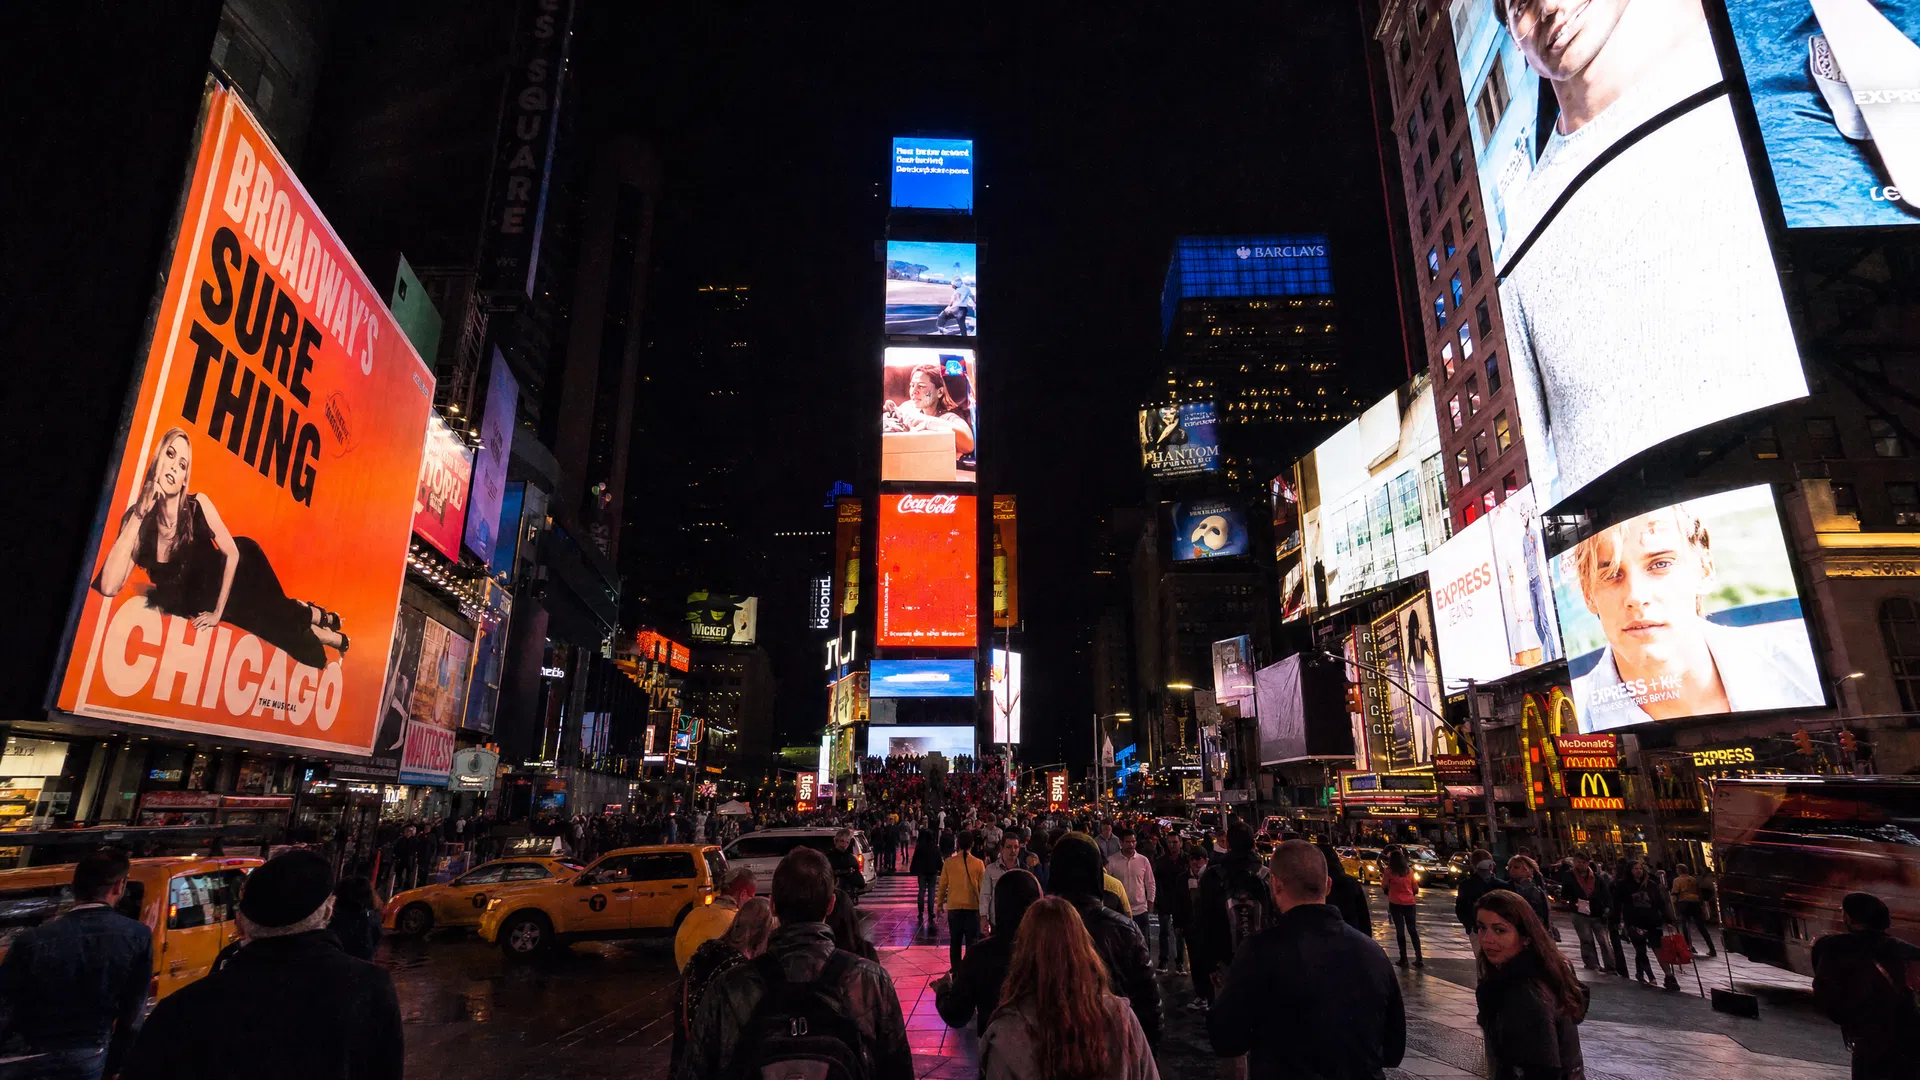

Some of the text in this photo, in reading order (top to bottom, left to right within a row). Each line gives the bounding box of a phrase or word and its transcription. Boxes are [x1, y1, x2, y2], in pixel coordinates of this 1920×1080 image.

[501, 58, 548, 234] SQUARE
[222, 134, 379, 376] BROADWAY'S
[1255, 245, 1325, 258] BARCLAYS
[200, 226, 322, 408] SURE
[181, 319, 321, 508] THING
[1143, 444, 1220, 465] PHANTOM
[1435, 562, 1492, 611] EXPRESS
[101, 595, 343, 731] CHICAGO
[259, 697, 297, 713] THE MUSICAL
[1591, 678, 1648, 706] EXPRESS
[1649, 689, 1680, 703] BRYAN
[404, 722, 454, 772] WAITRESS
[1560, 740, 1614, 748] McDonald's
[1693, 747, 1755, 767] EXPRESS
